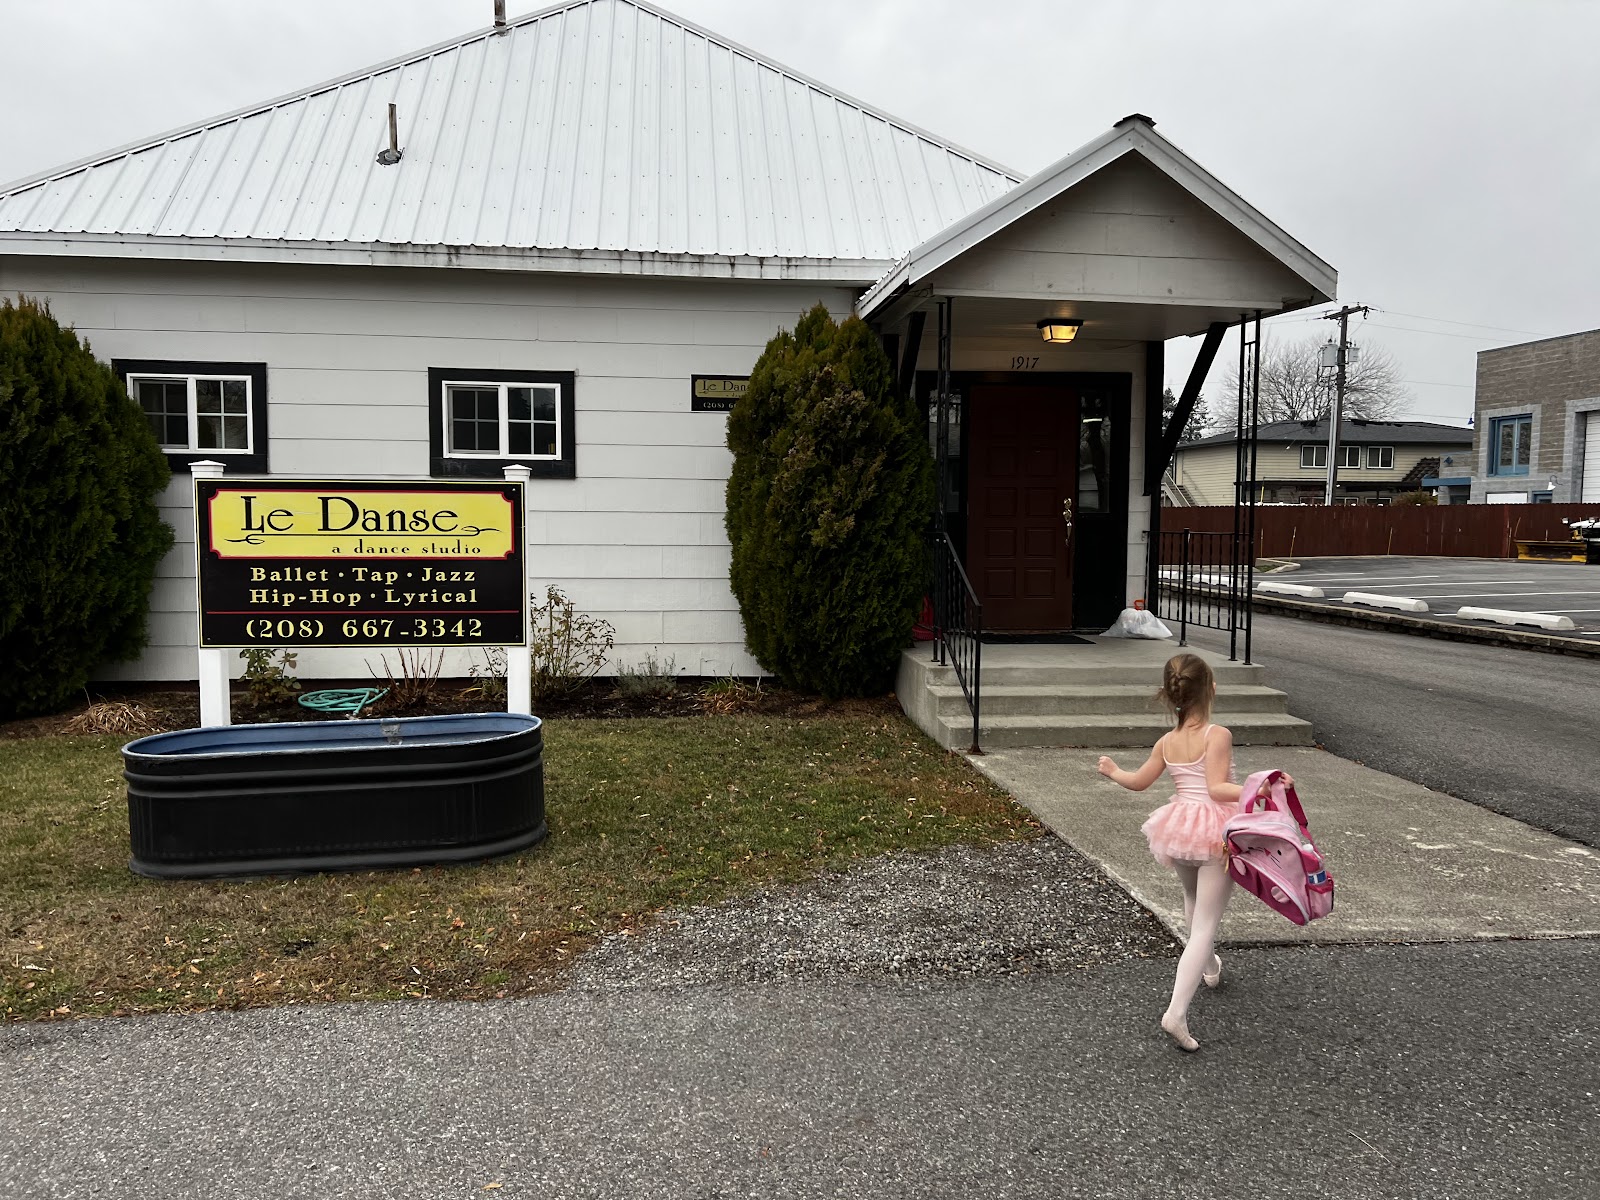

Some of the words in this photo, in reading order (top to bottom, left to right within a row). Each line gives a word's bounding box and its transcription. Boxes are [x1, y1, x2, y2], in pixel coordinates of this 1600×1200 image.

[1010, 355, 1040, 370] 1917
[702, 380, 717, 391] Le
[723, 380, 749, 391] Dan
[240, 495, 294, 533] Le
[318, 496, 459, 532] Danse
[332, 545, 341, 554] a
[353, 538, 410, 554] dance
[422, 538, 481, 554] studio
[250, 567, 329, 582] Ballet
[352, 567, 399, 584] Tap
[421, 567, 476, 582] Jazz
[249, 588, 362, 606] Hip-Hop
[384, 588, 478, 606] Lyrical
[246, 619, 324, 638] (208)
[342, 618, 482, 638] 667-3342
